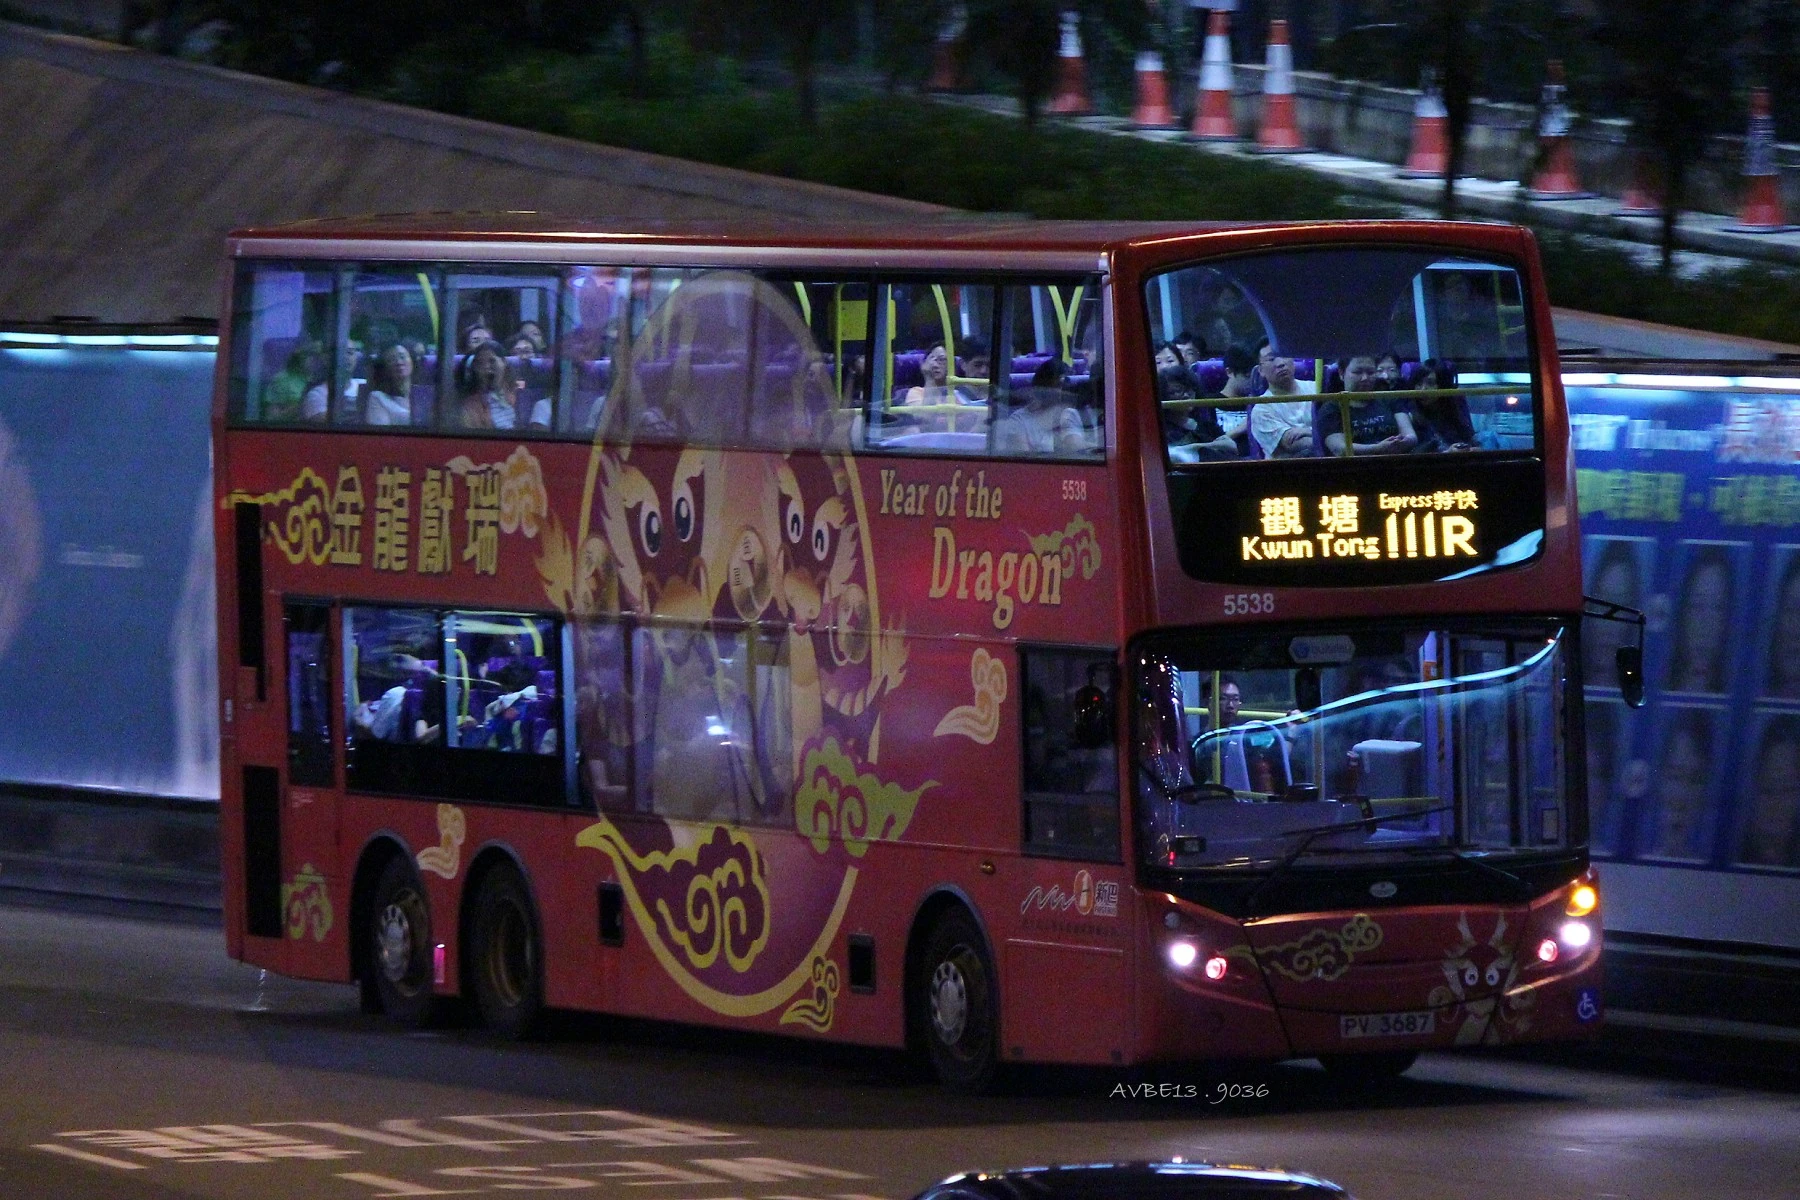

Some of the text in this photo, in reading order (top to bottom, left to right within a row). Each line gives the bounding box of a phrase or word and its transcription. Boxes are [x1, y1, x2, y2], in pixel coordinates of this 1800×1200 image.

[880, 469, 1002, 518] Year of the
[1062, 479, 1087, 501] 5538
[1379, 490, 1479, 512] Express 特快
[330, 465, 501, 575] 金龍獻瑞
[1260, 495, 1359, 535] 觀塘
[1386, 511, 1478, 558] 111R
[1242, 536, 1313, 560] Kwun
[929, 527, 1062, 629] Dragon
[1224, 593, 1275, 615] 5538
[1345, 1014, 1430, 1035] PV 3687
[334, 1157, 873, 1197] WEST
